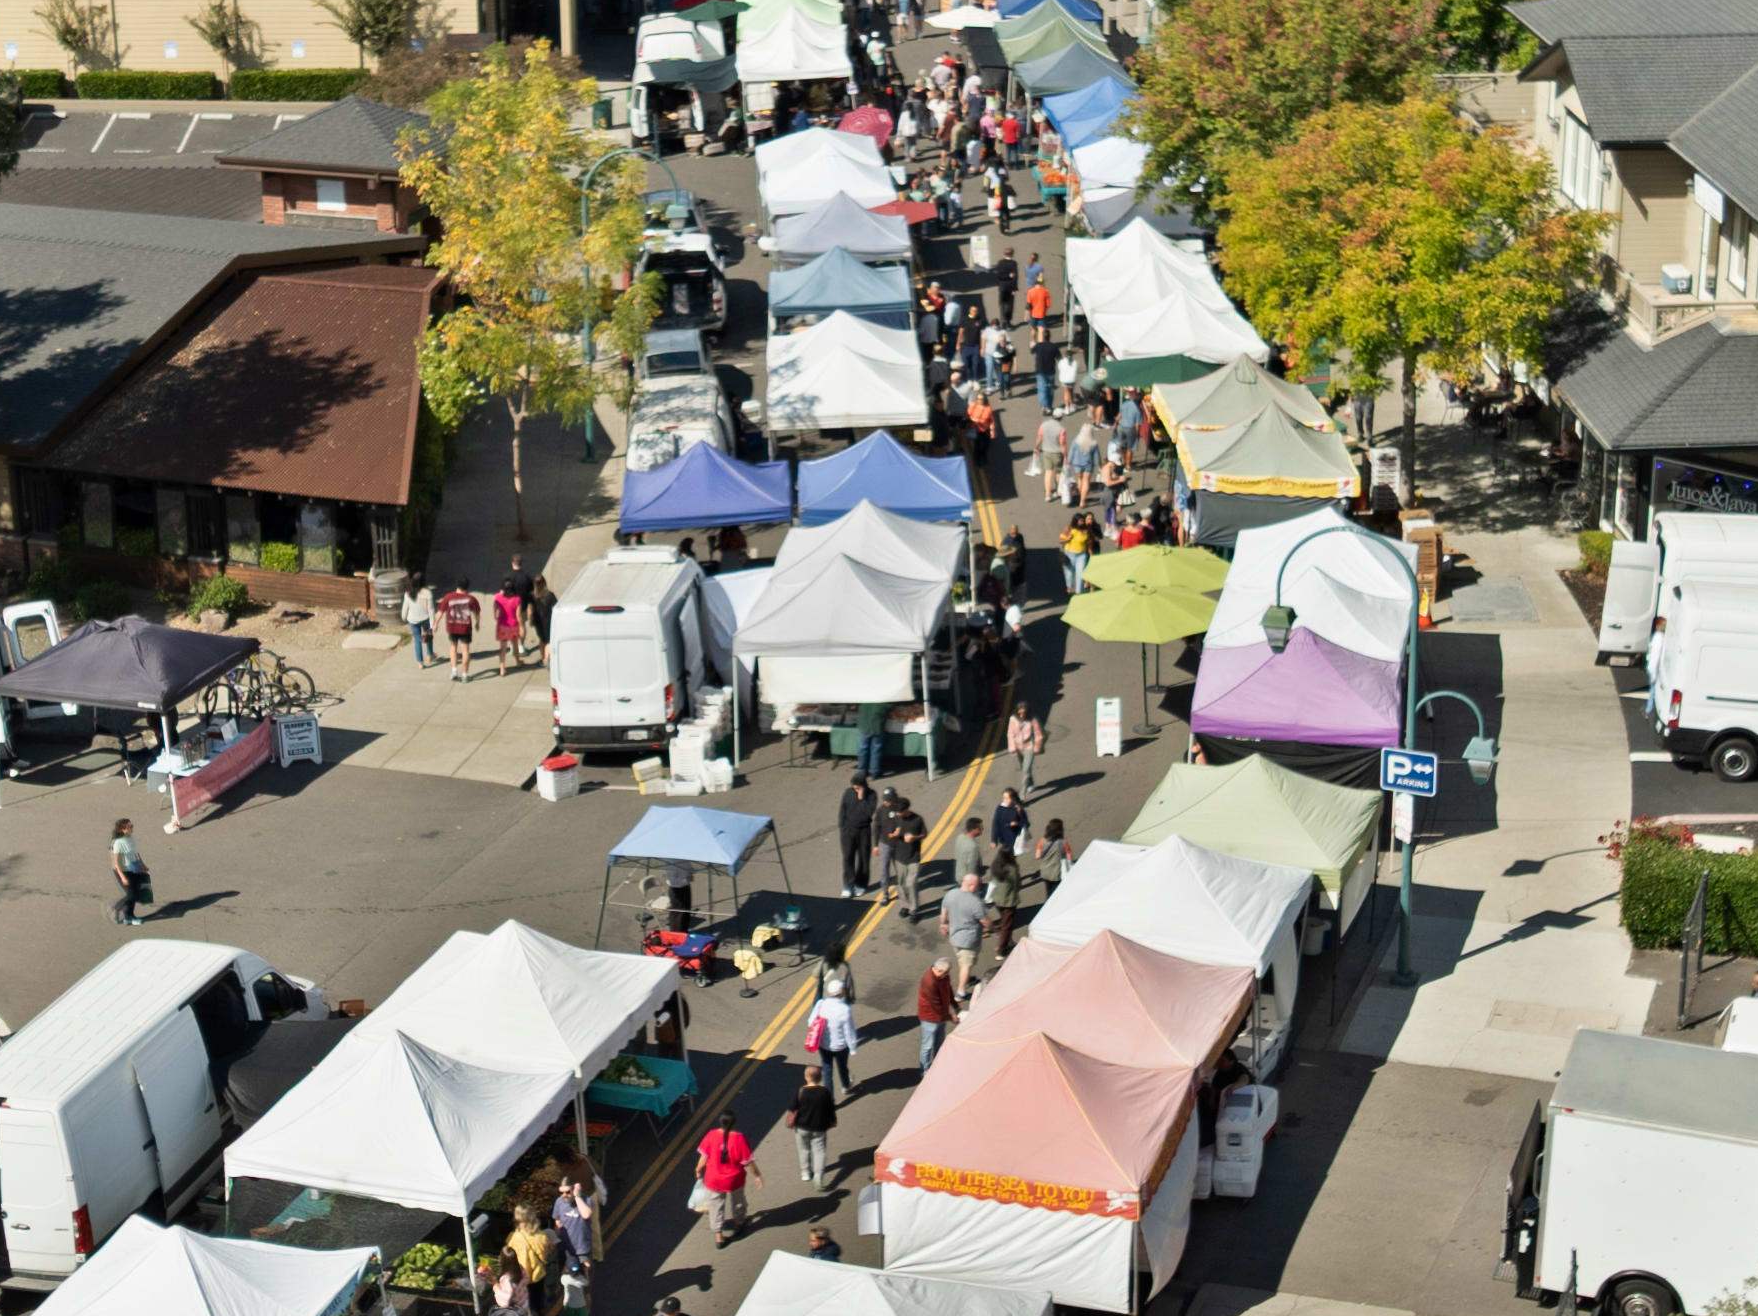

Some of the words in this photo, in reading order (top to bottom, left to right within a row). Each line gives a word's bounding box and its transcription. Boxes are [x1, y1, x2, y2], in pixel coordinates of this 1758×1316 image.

[915, 1162, 961, 1184] FROM
[964, 1169, 996, 1189] THE
[999, 1175, 1029, 1194] SEA
[1034, 1181, 1057, 1199] TO
[1059, 1186, 1095, 1202] YOU
